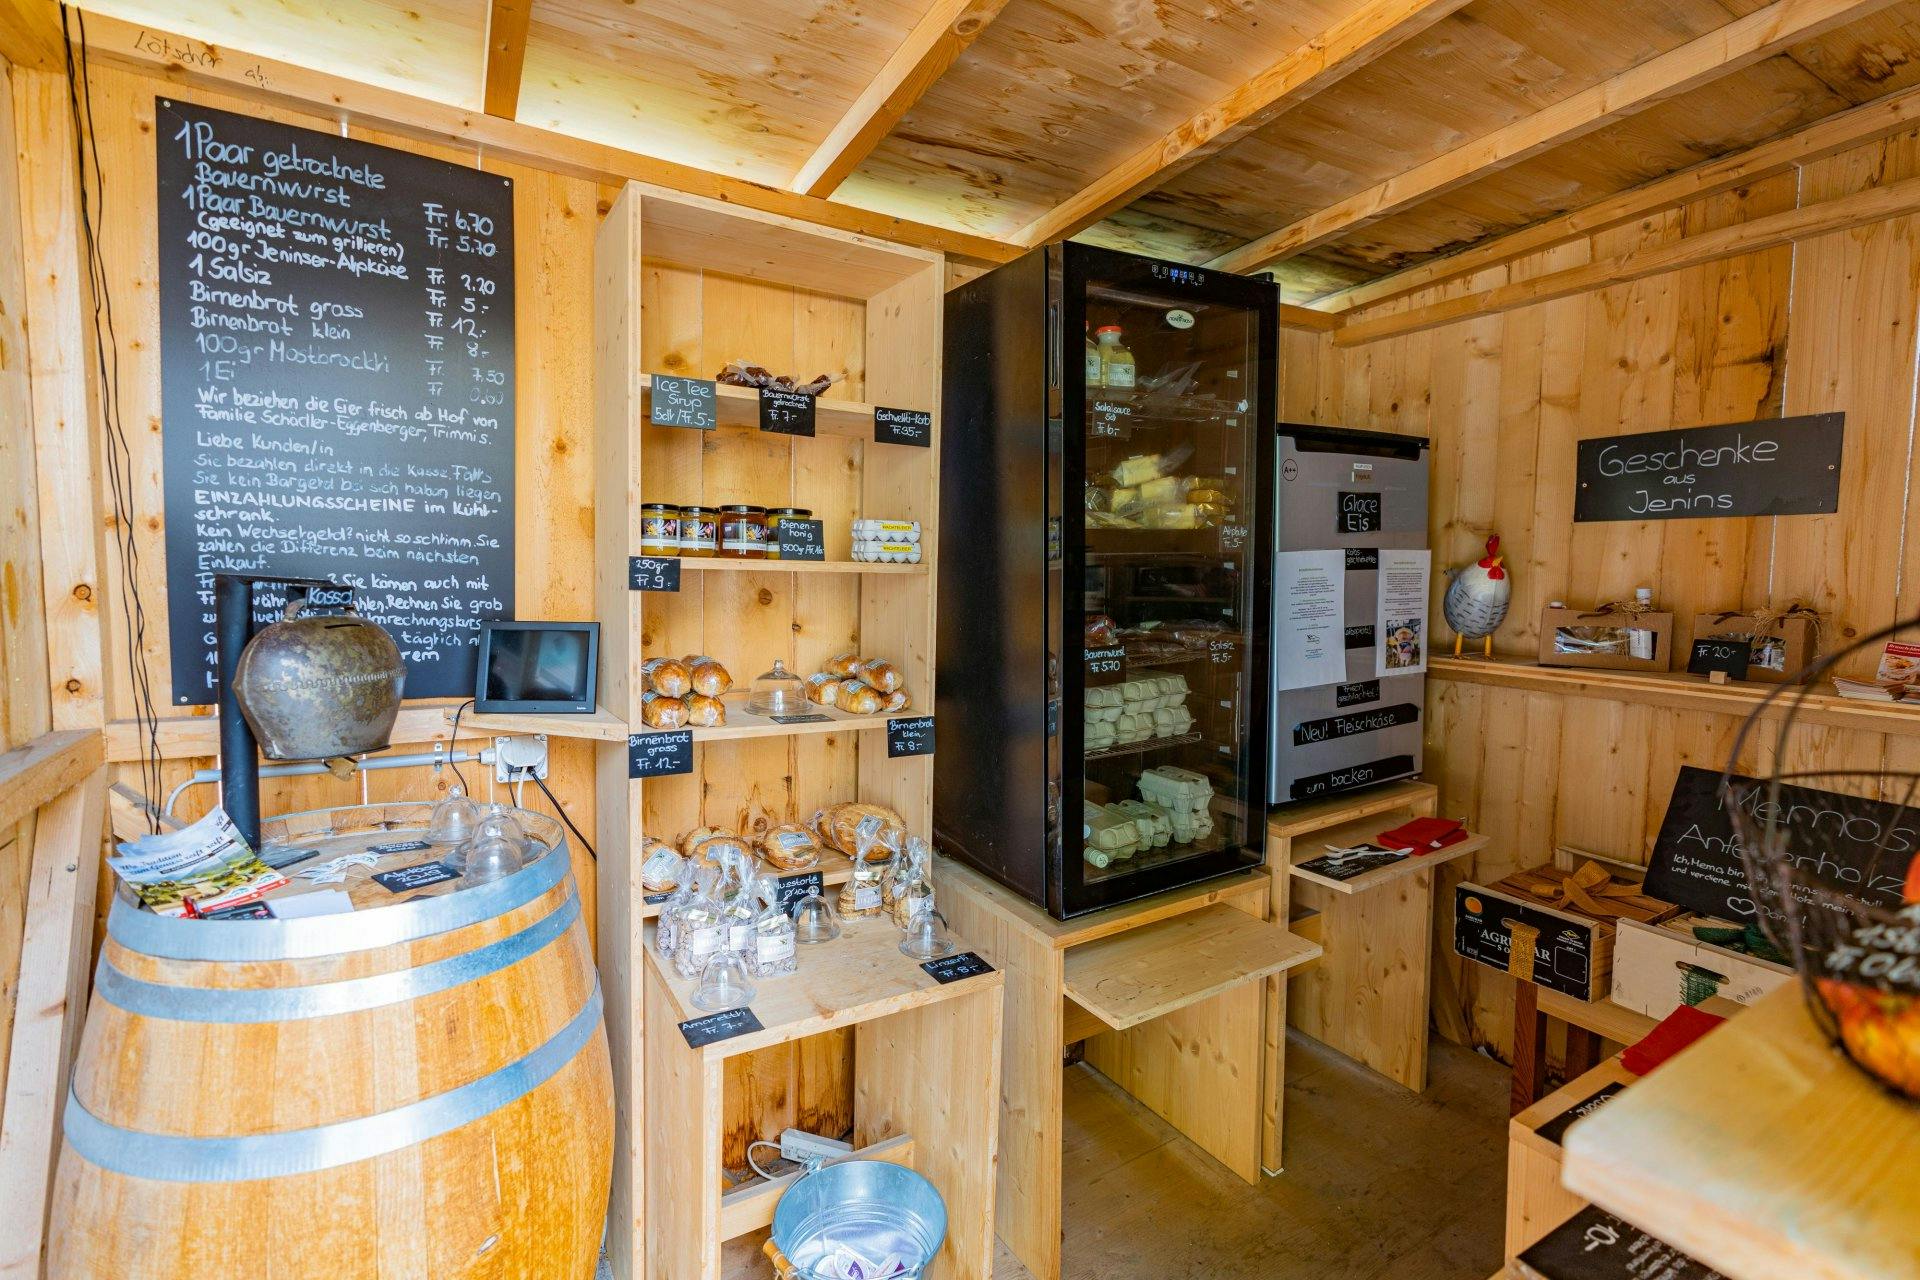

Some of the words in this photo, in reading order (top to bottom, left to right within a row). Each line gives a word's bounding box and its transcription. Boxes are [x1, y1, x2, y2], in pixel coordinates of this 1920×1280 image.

[262, 143, 386, 189] getrocknete
[194, 161, 351, 208] Bauernwurst
[422, 202, 448, 228] Fr.
[455, 209, 495, 236] 6.70
[247, 195, 391, 241] Bauernwurst
[425, 226, 449, 248] Fr.
[456, 235, 497, 257] 5.70
[292, 231, 328, 246] zum
[332, 235, 405, 263] grillieren)
[208, 257, 273, 286] Salsiz
[460, 274, 496, 296] 2.20
[189, 281, 300, 317] Birnenbrot
[309, 301, 365, 321] gross
[190, 306, 293, 337] Birnenbrot
[311, 322, 351, 341] klein
[656, 376, 681, 394] Ice
[683, 379, 711, 398] Tee
[197, 385, 228, 405] Wir
[232, 386, 299, 409] beziehen
[305, 395, 329, 412] die
[334, 397, 362, 416] Eier
[368, 400, 408, 421] frisch
[415, 405, 432, 421] ab
[438, 407, 469, 425] Hof
[472, 416, 498, 430] von
[667, 393, 702, 412] Sirup
[194, 403, 257, 424] Familie
[197, 430, 244, 450] Liebe
[251, 432, 334, 456] Kunden/in
[193, 453, 222, 467] Sie
[226, 454, 297, 473] bezahlen
[304, 458, 354, 475] direkt
[360, 462, 374, 477] in
[379, 464, 400, 477] die
[1598, 432, 1779, 477] Geschenke
[1283, 466, 1297, 474] A++
[1662, 473, 1696, 485] aus
[191, 470, 220, 486] Sie
[228, 471, 262, 488] kein
[265, 472, 334, 493] Bargeld
[369, 481, 399, 496] sich
[404, 482, 449, 500] haben
[456, 485, 502, 504] liegen
[193, 489, 416, 513] EINZAHLUNGSSCHEINE
[424, 500, 446, 515] im
[1343, 494, 1378, 514] Glace
[1628, 488, 1734, 514] Jenins
[193, 505, 280, 523] schrank.
[1347, 512, 1370, 532] Eis
[196, 523, 232, 539] Kein
[237, 524, 353, 544] Wechselgeld?
[355, 529, 391, 544] nicht
[789, 528, 813, 541] honig
[196, 538, 246, 554] zahlen
[250, 540, 277, 555] die
[280, 540, 360, 558] Differenz
[364, 544, 401, 560] beim
[406, 549, 480, 566] nächsten
[197, 553, 272, 572] Einkauf.
[635, 559, 669, 577] 250gr
[423, 574, 460, 590] auch
[466, 574, 489, 591] mit
[634, 573, 650, 589] Fr.
[307, 586, 354, 606] Kassa
[386, 594, 439, 611] Rechnen
[441, 595, 463, 610] Sie
[470, 597, 504, 616] grob
[400, 630, 462, 651] täglich
[888, 717, 934, 730] Birnenbrot
[1301, 720, 1329, 742] Neu!
[1334, 712, 1398, 735] Fleischkäse
[628, 733, 690, 748] Birnenbrot
[647, 743, 678, 756] gross
[635, 758, 653, 770] Fr.
[1331, 768, 1373, 787] backen
[1671, 866, 1687, 875] und
[1690, 870, 1731, 887] verdiene
[1727, 866, 1745, 880] bin
